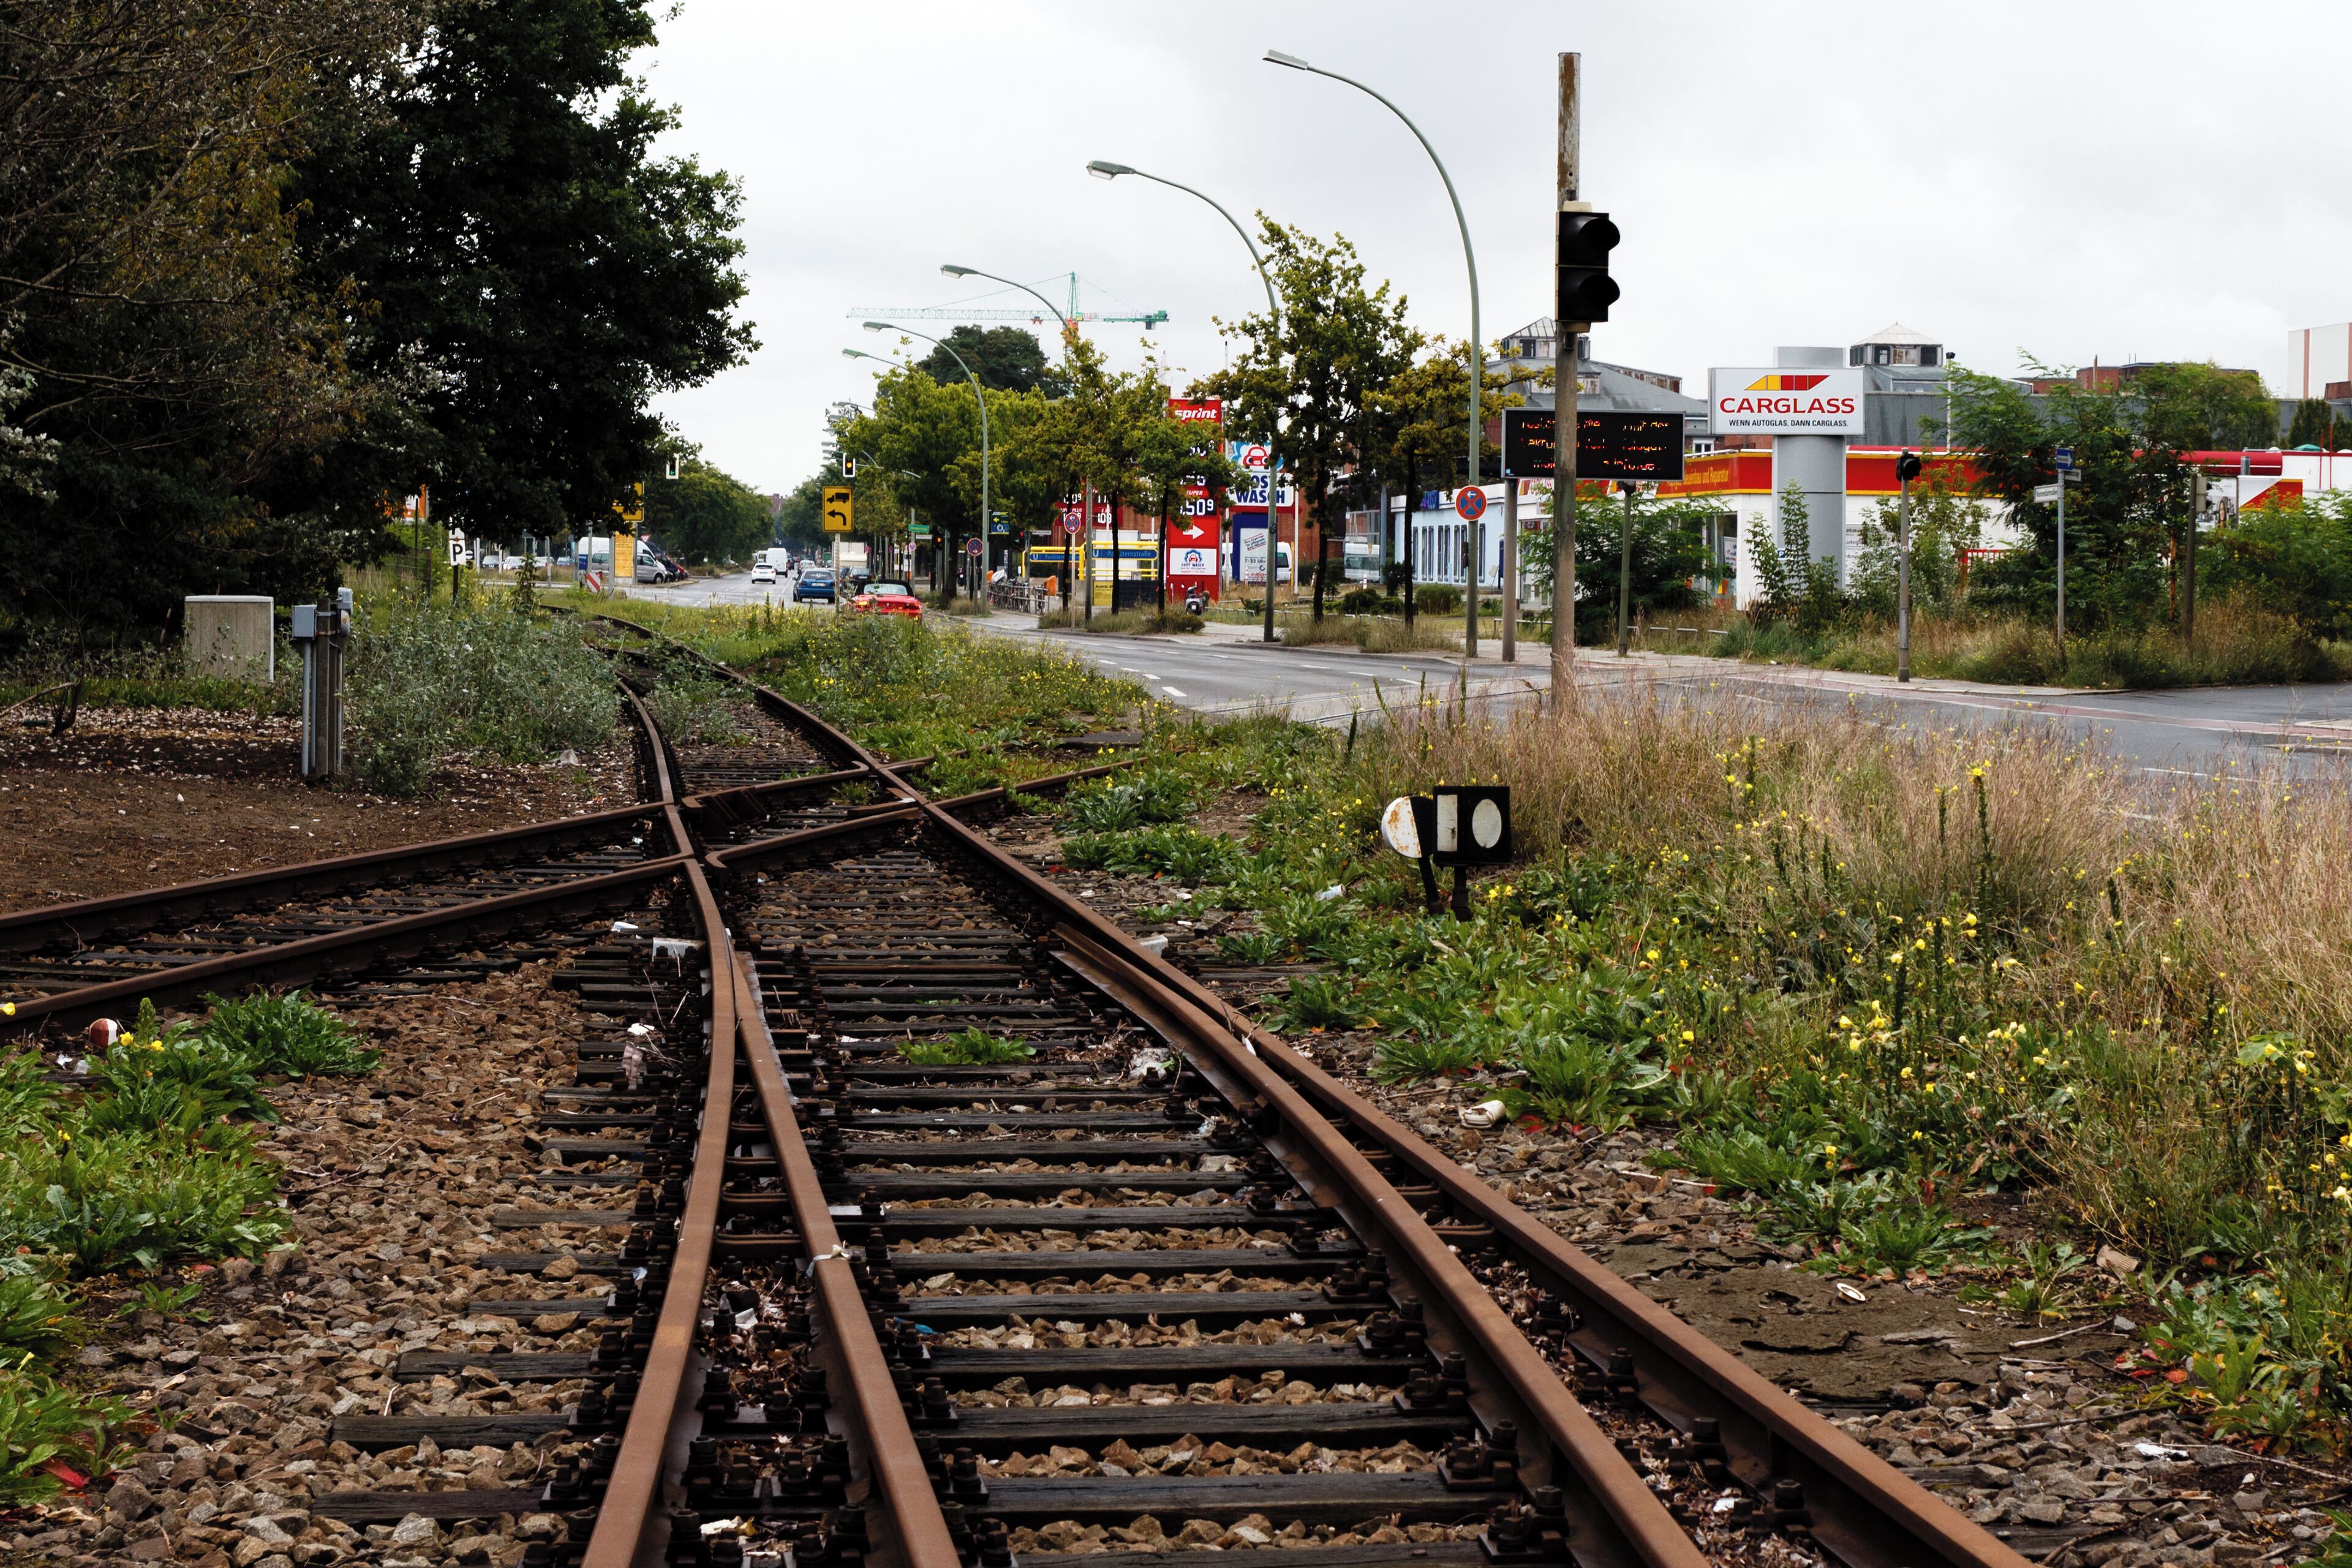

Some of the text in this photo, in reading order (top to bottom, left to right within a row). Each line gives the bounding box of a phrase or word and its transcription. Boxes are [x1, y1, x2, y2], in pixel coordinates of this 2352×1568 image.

[1720, 398, 1855, 413] CARGLASS
[1174, 408, 1218, 420] sprint
[1235, 489, 1285, 503] WASH
[453, 544, 463, 562] P
